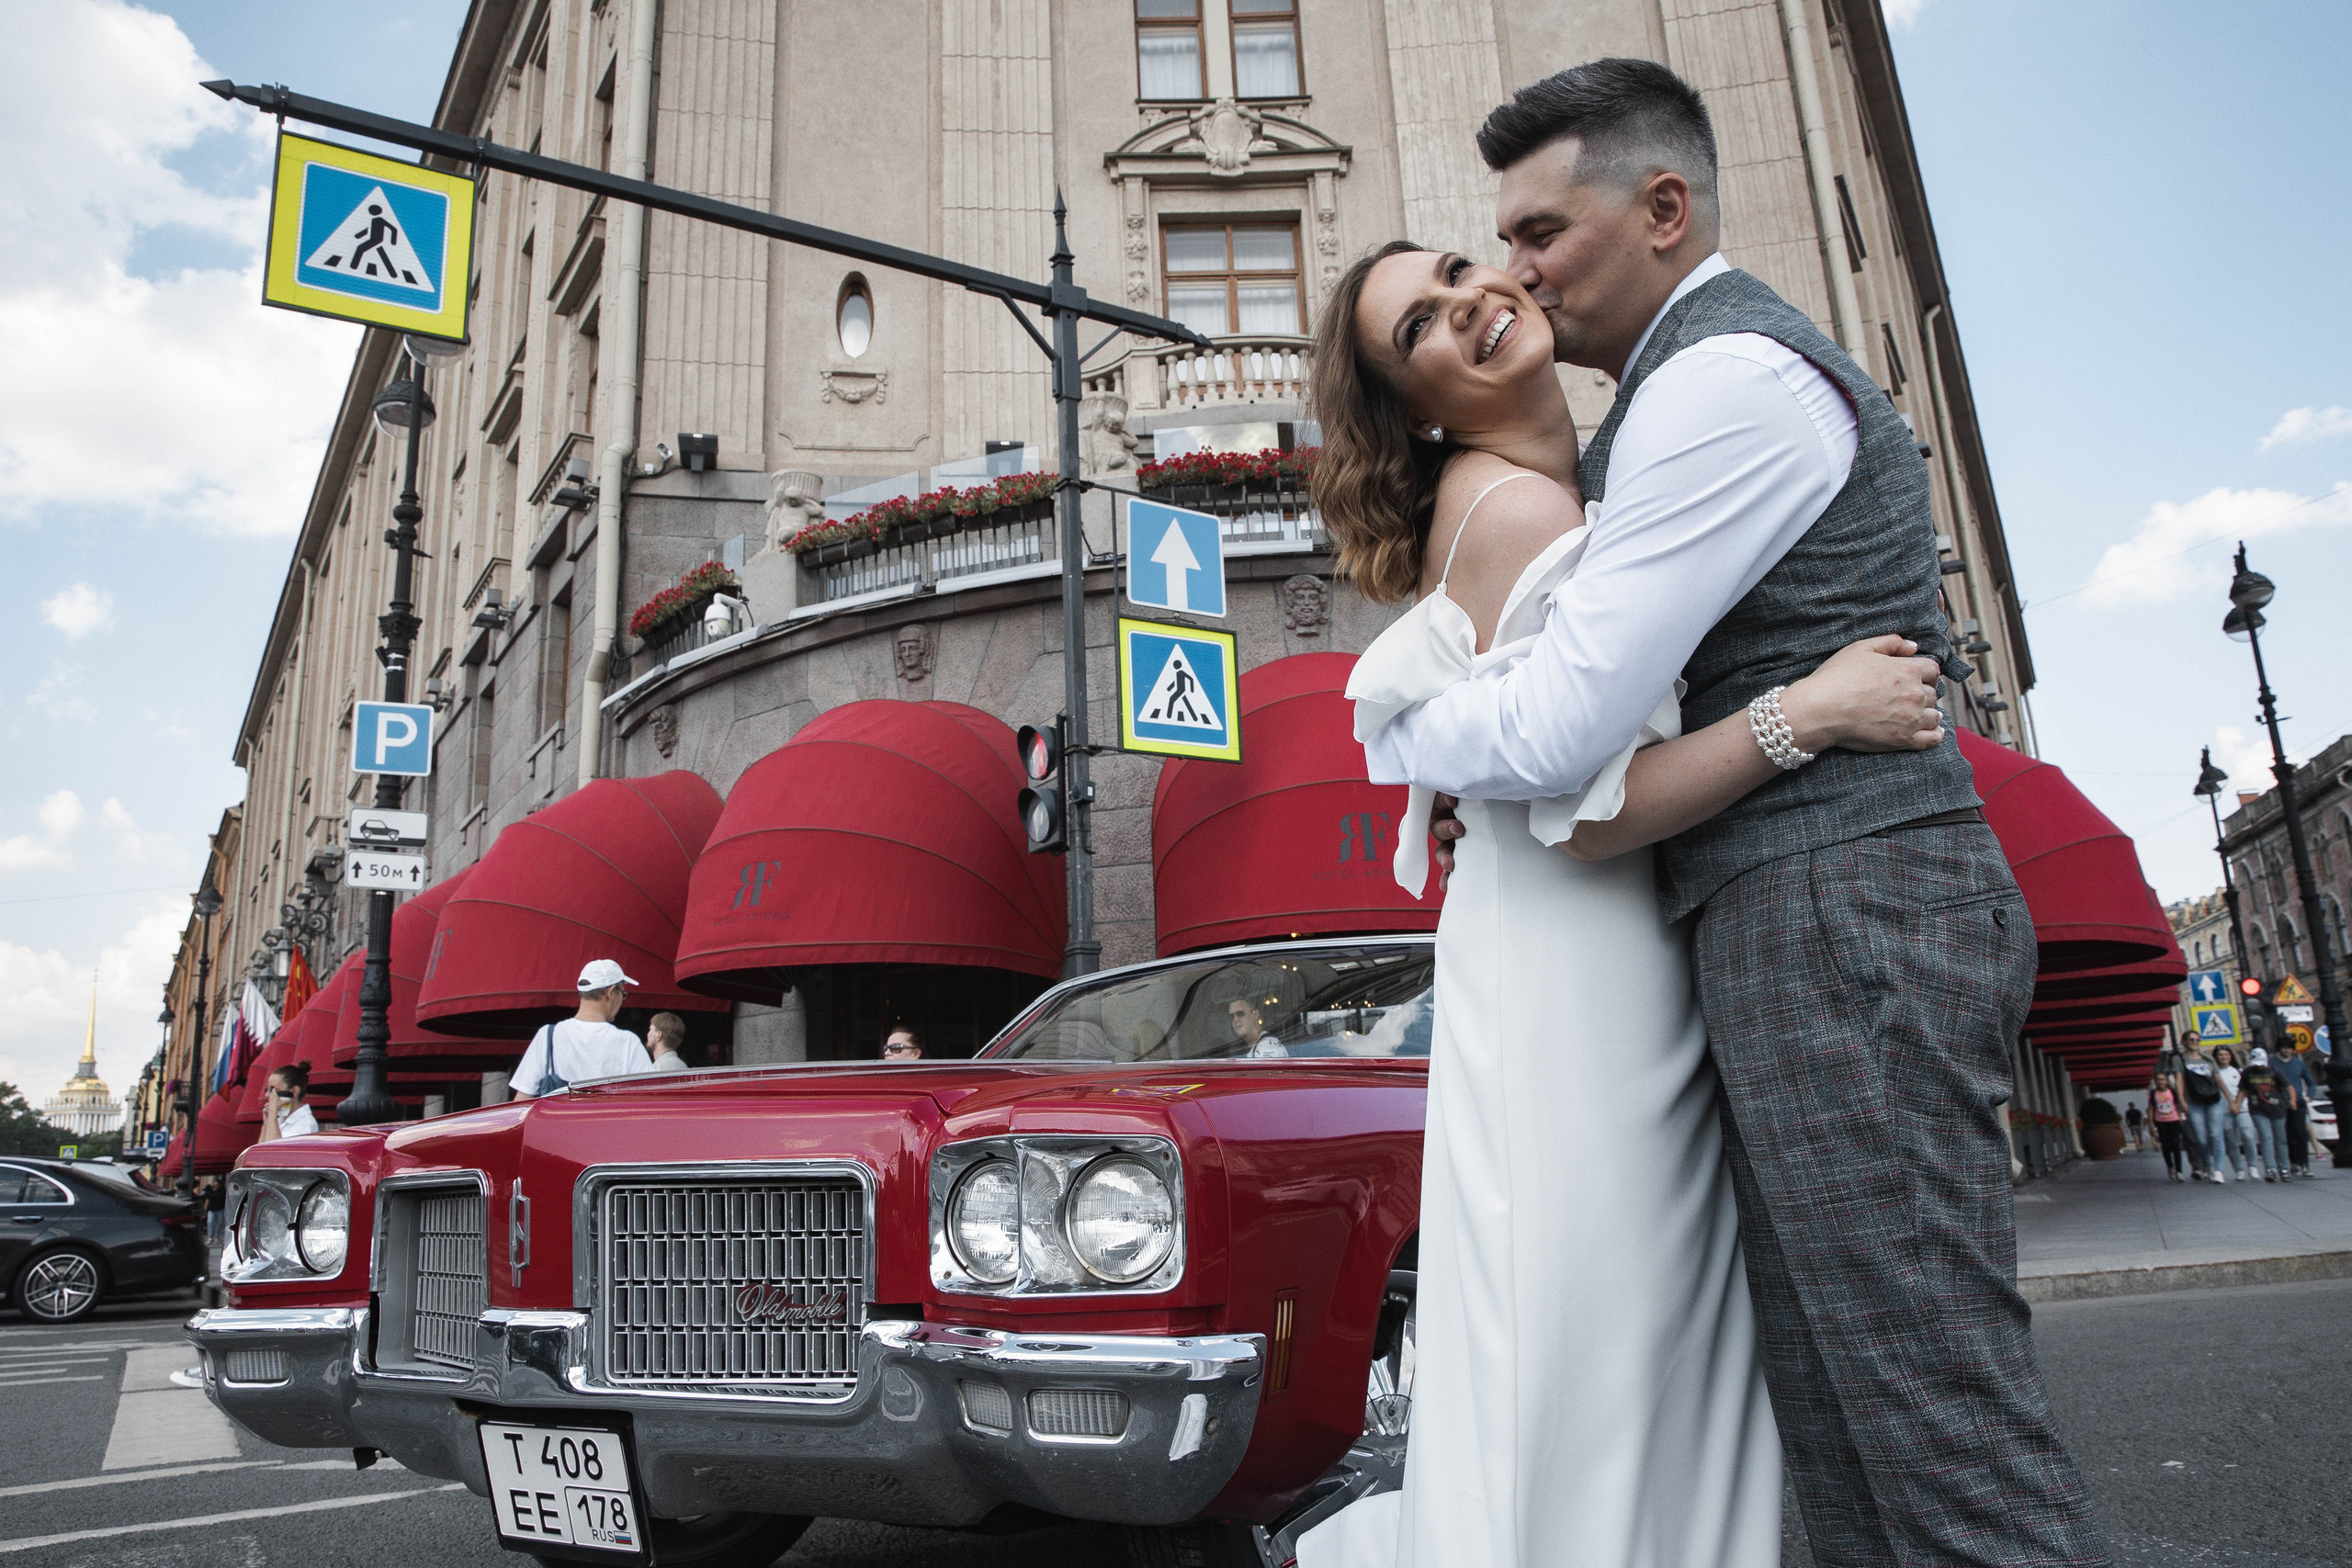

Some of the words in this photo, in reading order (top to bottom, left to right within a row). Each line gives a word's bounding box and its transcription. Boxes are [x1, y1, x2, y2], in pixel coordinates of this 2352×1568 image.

[375, 711, 418, 765] P
[1312, 869, 1355, 881] HOTEL
[1363, 868, 1395, 878] ASTO
[153, 1133, 164, 1146] P
[736, 1283, 844, 1323] Oldsmobile
[541, 1435, 604, 1481] 408
[577, 1494, 628, 1531] 178
[592, 1529, 615, 1542] RUS
